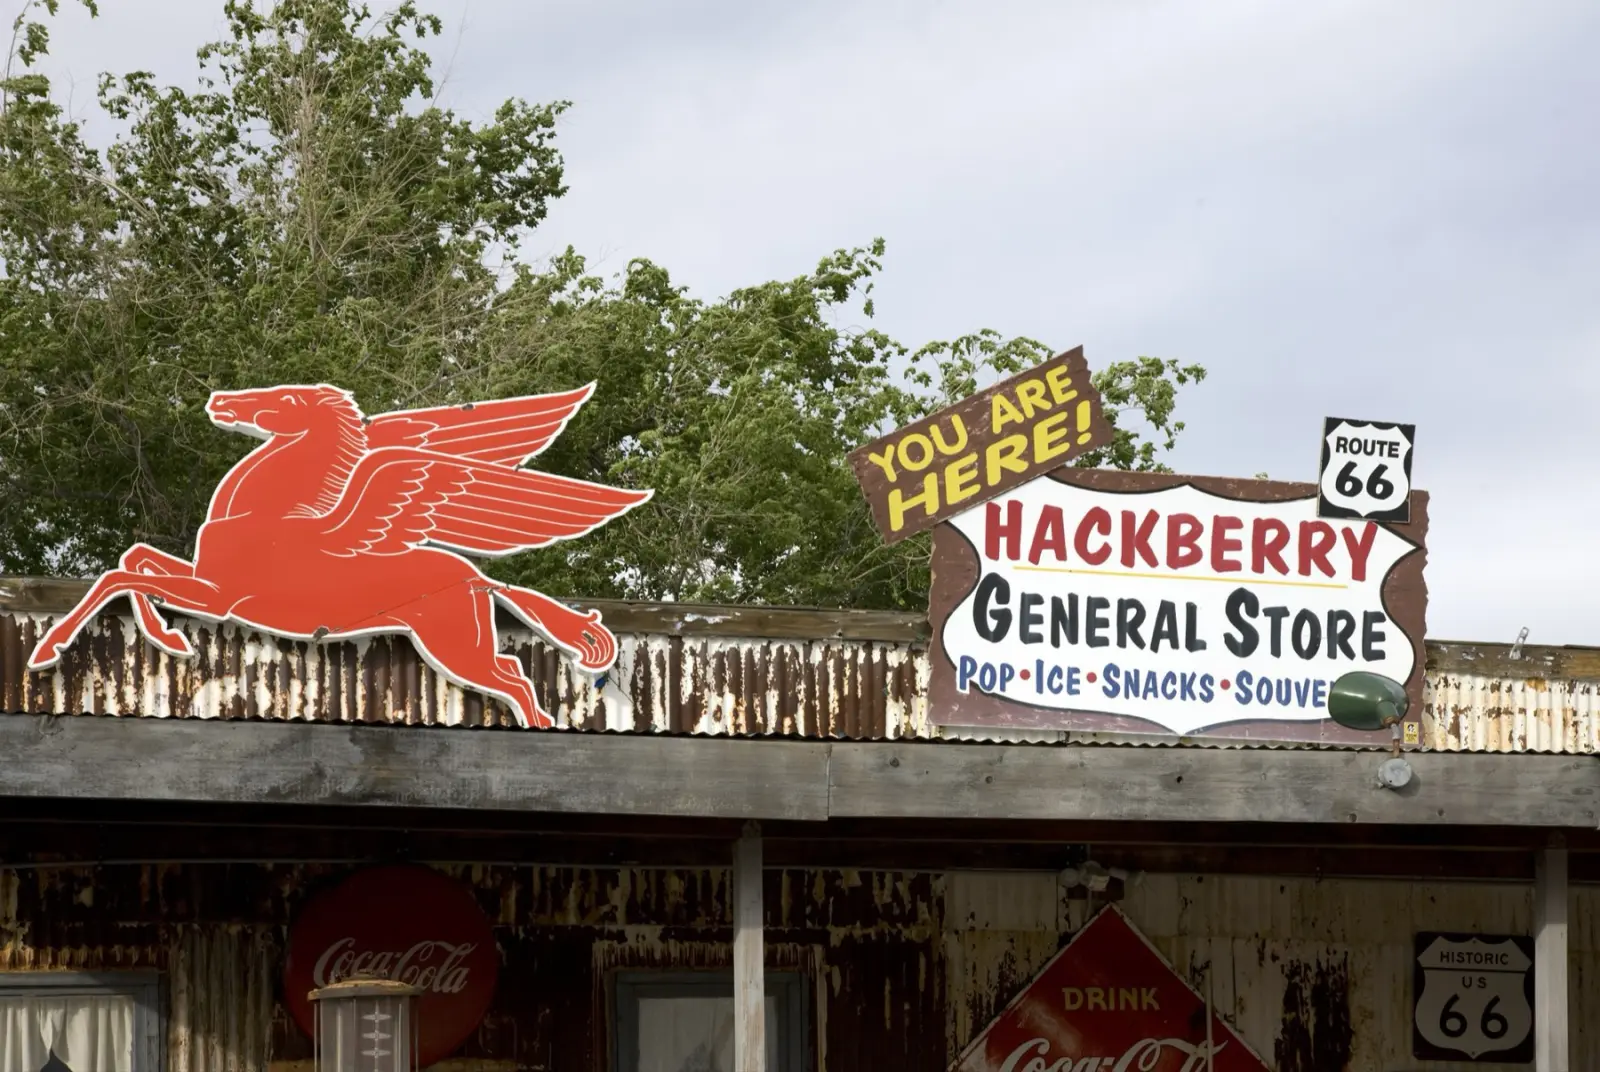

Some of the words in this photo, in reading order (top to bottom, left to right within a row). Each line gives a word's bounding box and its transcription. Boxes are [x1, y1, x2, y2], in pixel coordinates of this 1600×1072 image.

[868, 414, 968, 482] YOU
[992, 364, 1078, 434] ARE
[1335, 436, 1400, 458] ROUTE
[888, 400, 1092, 531] HERE!
[1335, 460, 1394, 500] 66
[984, 500, 1379, 581] HACKBERRY
[973, 572, 1207, 653] GENERAL
[1223, 587, 1387, 661] STORE
[959, 655, 1015, 692] POP
[1036, 659, 1080, 695] ICE
[1102, 663, 1214, 703] SNACKS
[1235, 669, 1335, 708] SOUVE
[313, 936, 479, 993] Coca-Cola
[1439, 951, 1509, 965] HISTORIC
[1462, 976, 1487, 989] US
[1062, 987, 1160, 1011] DRINK
[1439, 993, 1508, 1039] 66
